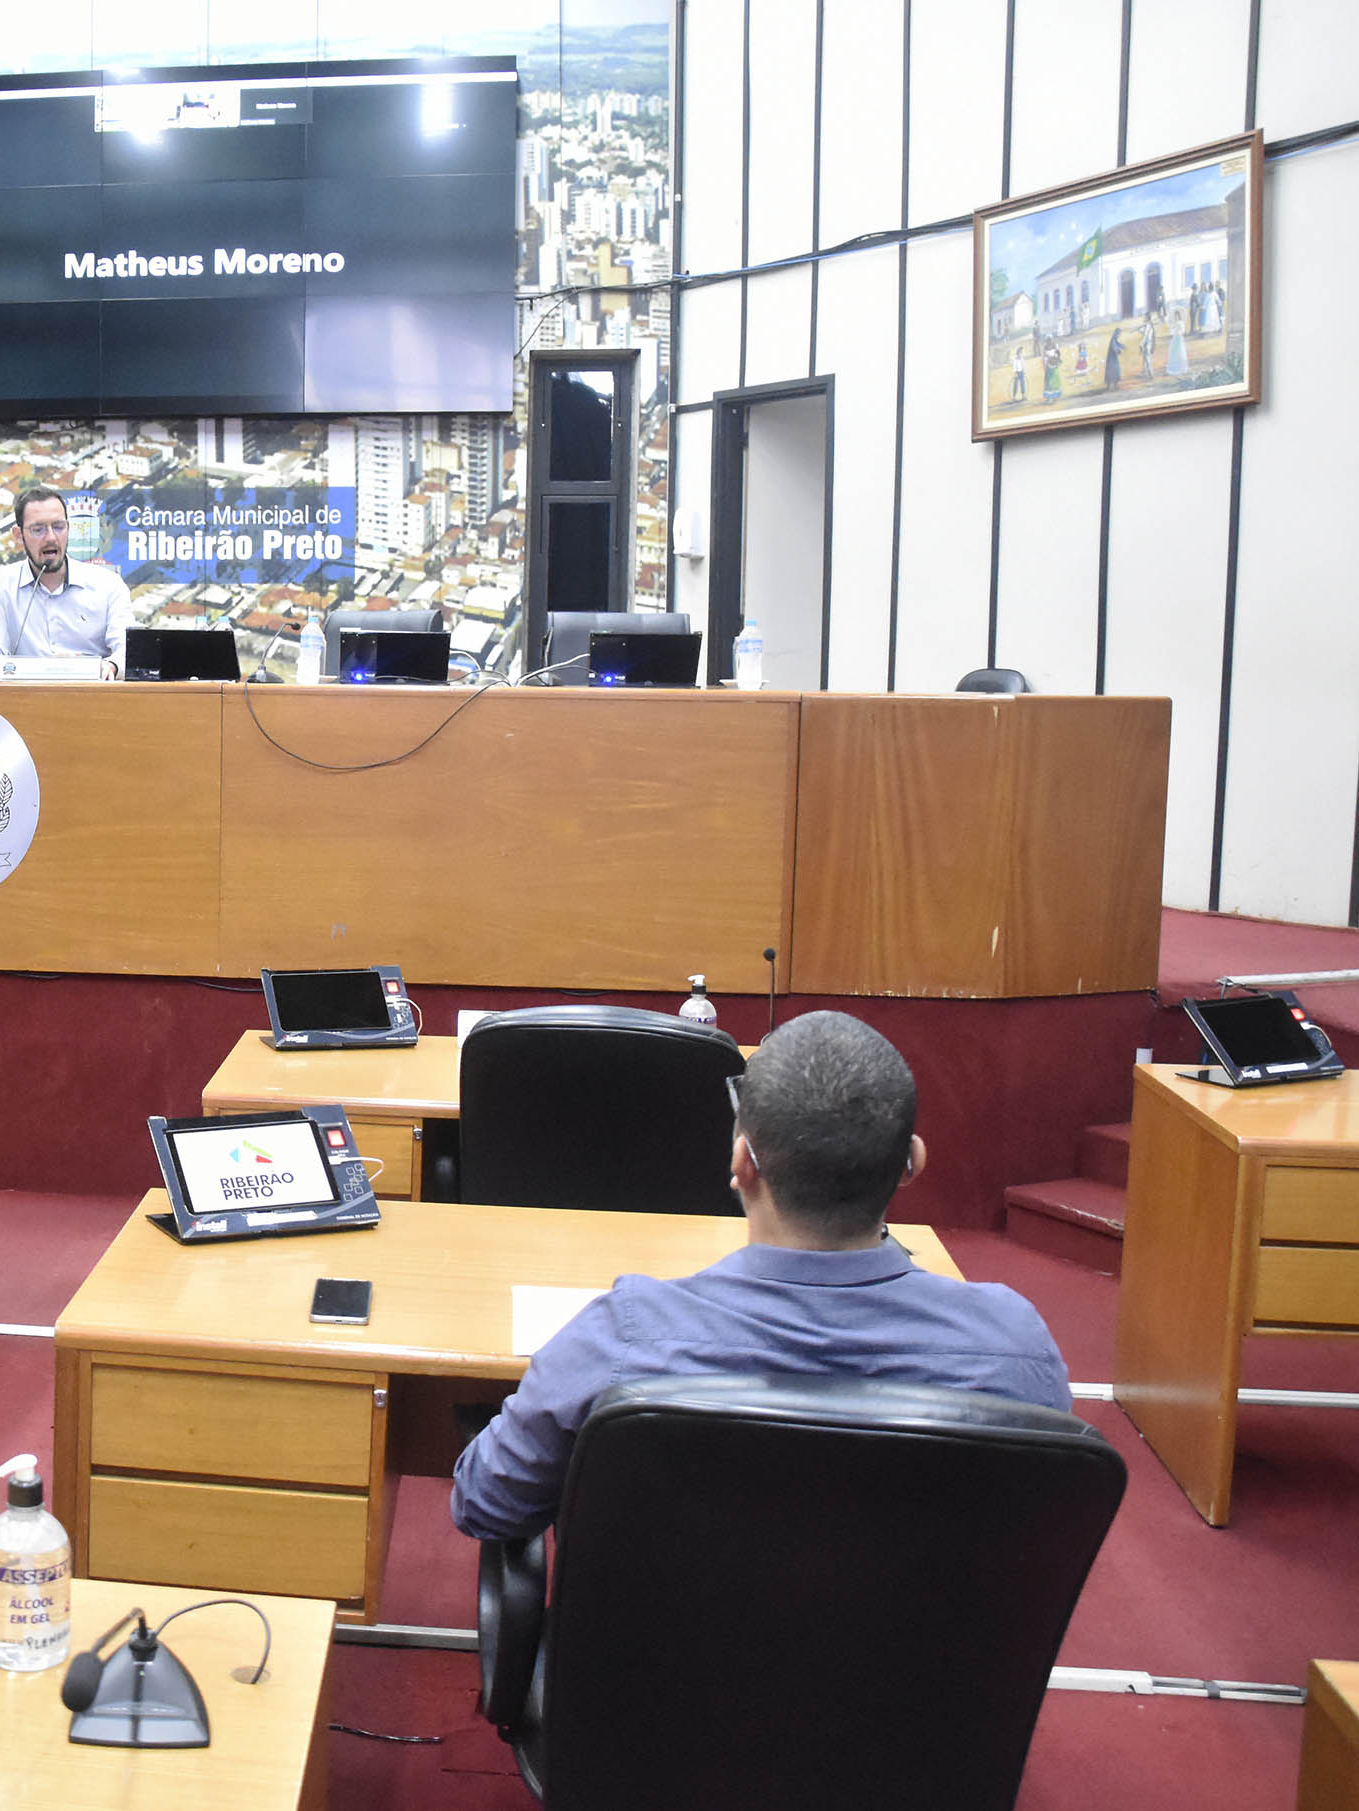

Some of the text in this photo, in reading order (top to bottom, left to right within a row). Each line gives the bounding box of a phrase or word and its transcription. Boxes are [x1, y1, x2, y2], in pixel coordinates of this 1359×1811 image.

[64, 247, 346, 279] Matheus Moreno
[125, 504, 342, 529] Câmara Municipal de
[128, 529, 343, 561] Ribeirão Preto
[223, 1185, 274, 1200] PRETO
[10, 1612, 51, 1625] EM GEL
